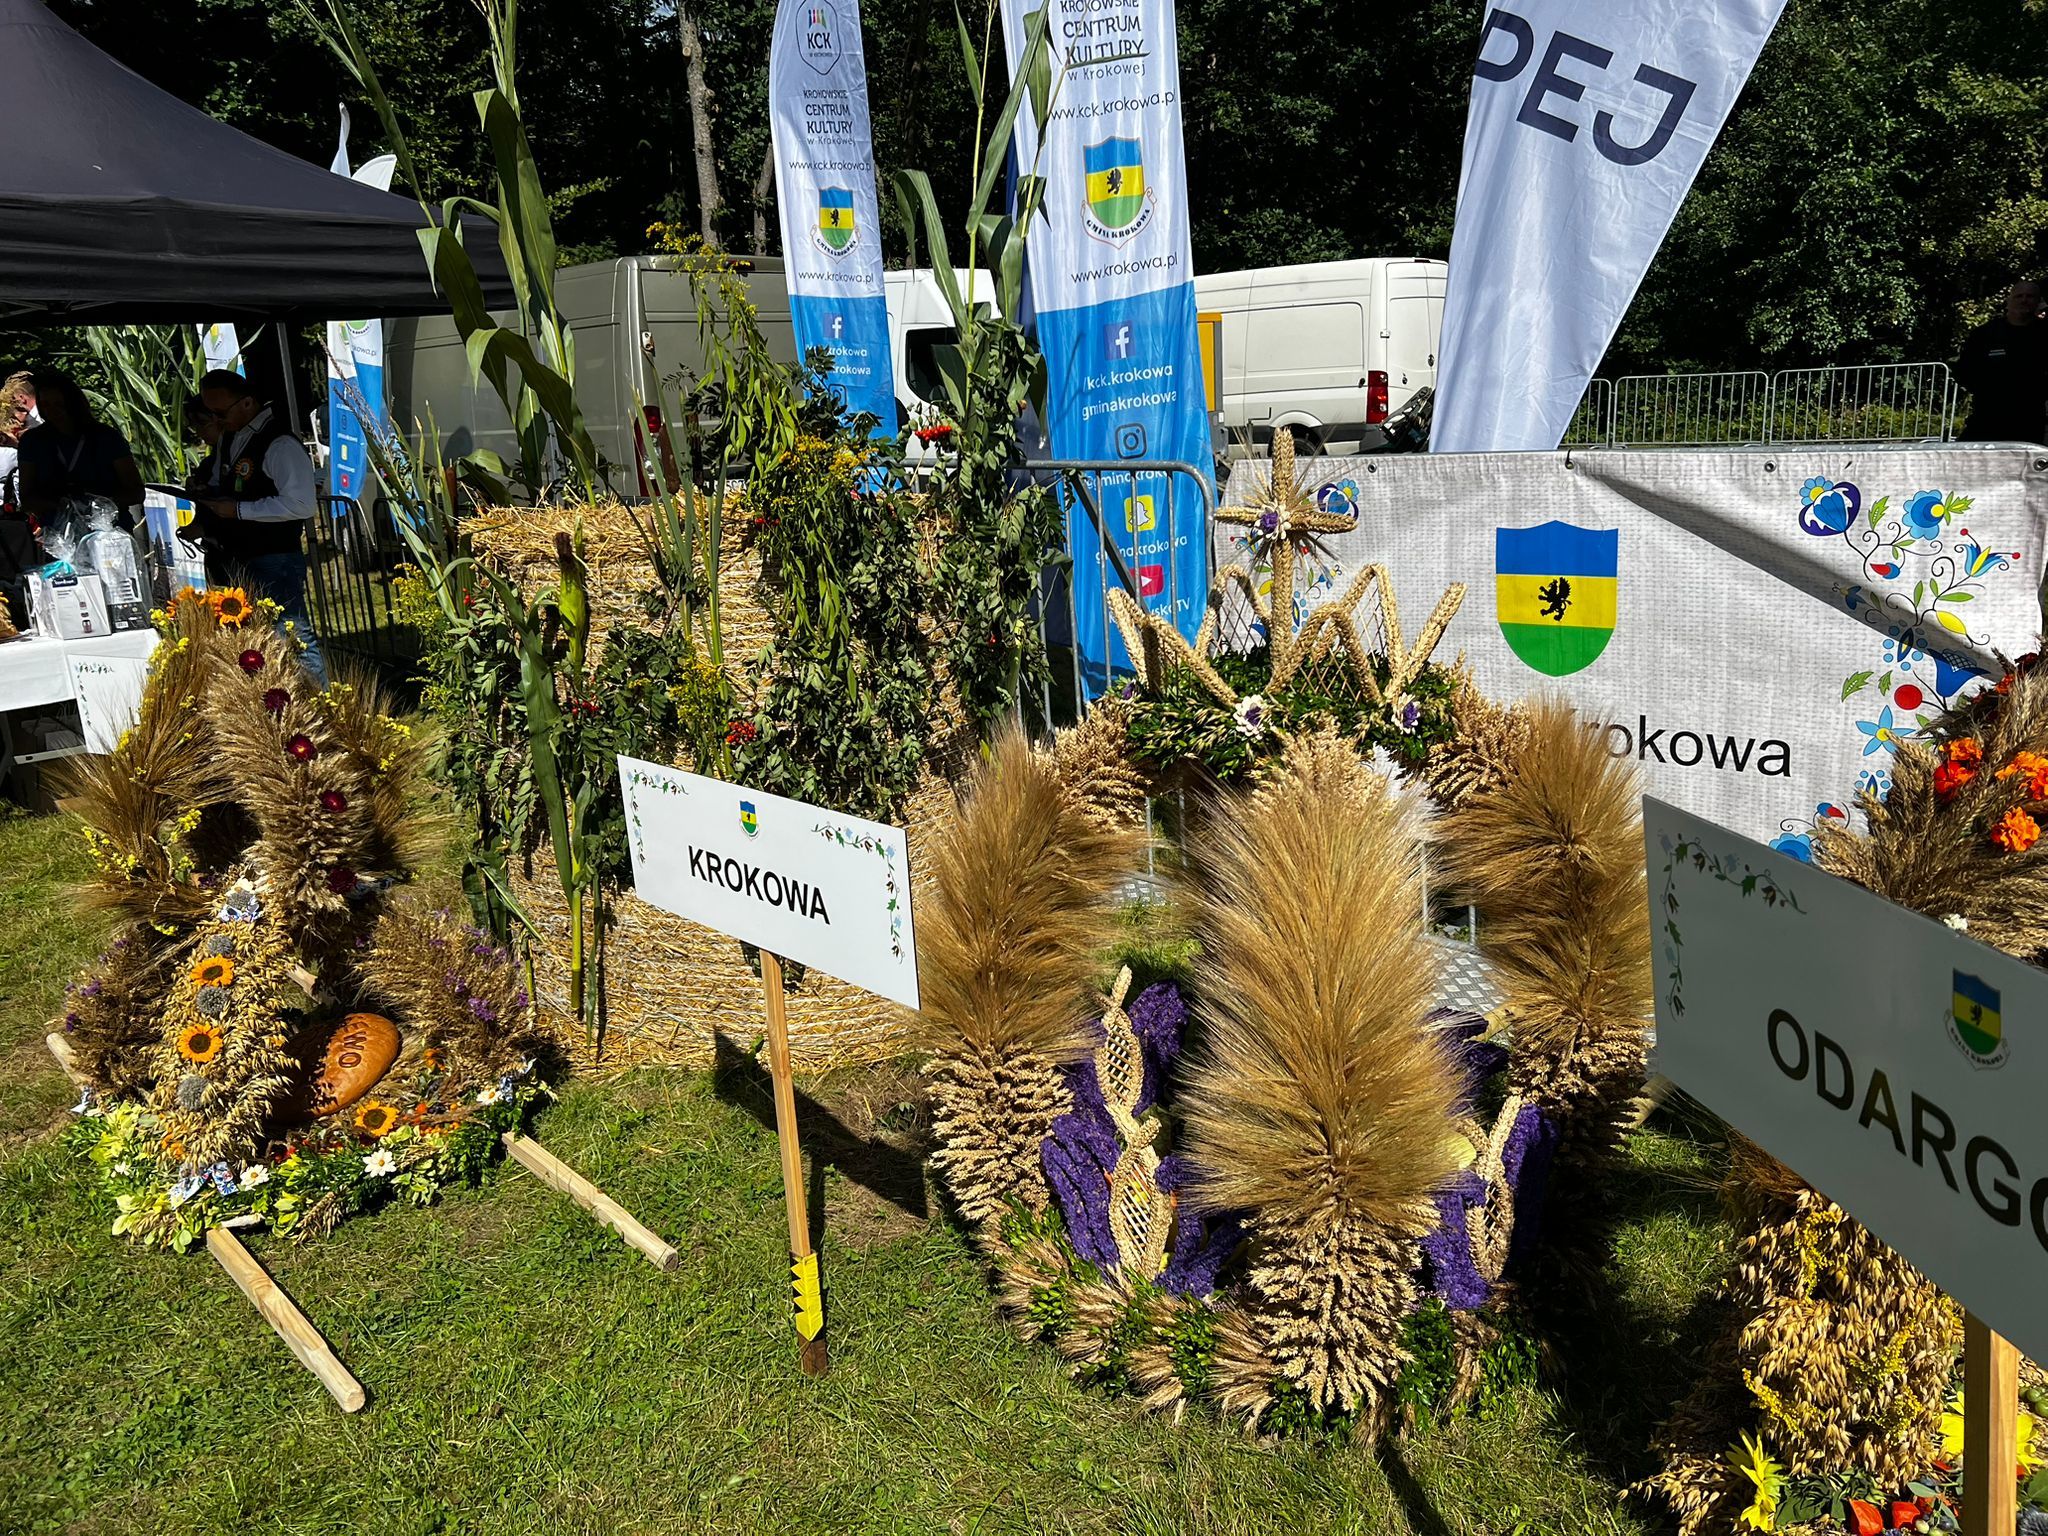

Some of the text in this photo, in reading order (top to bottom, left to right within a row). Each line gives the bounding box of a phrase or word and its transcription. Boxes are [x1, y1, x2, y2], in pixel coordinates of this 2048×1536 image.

[1063, 16, 1141, 38] CENTRUM
[807, 33, 832, 49] KCK
[1065, 39, 1144, 64] KULTURY
[1068, 63, 1146, 81] w Krokowej
[805, 104, 851, 116] CENTRUM
[807, 121, 853, 134] KULTURY
[818, 136, 856, 147] Krokowej
[1070, 251, 1179, 284] www.krokowa.pl
[798, 271, 874, 284] www.krokowa.pl
[1081, 390, 1177, 421] gminakrokowa
[688, 845, 831, 925] KROKOWA
